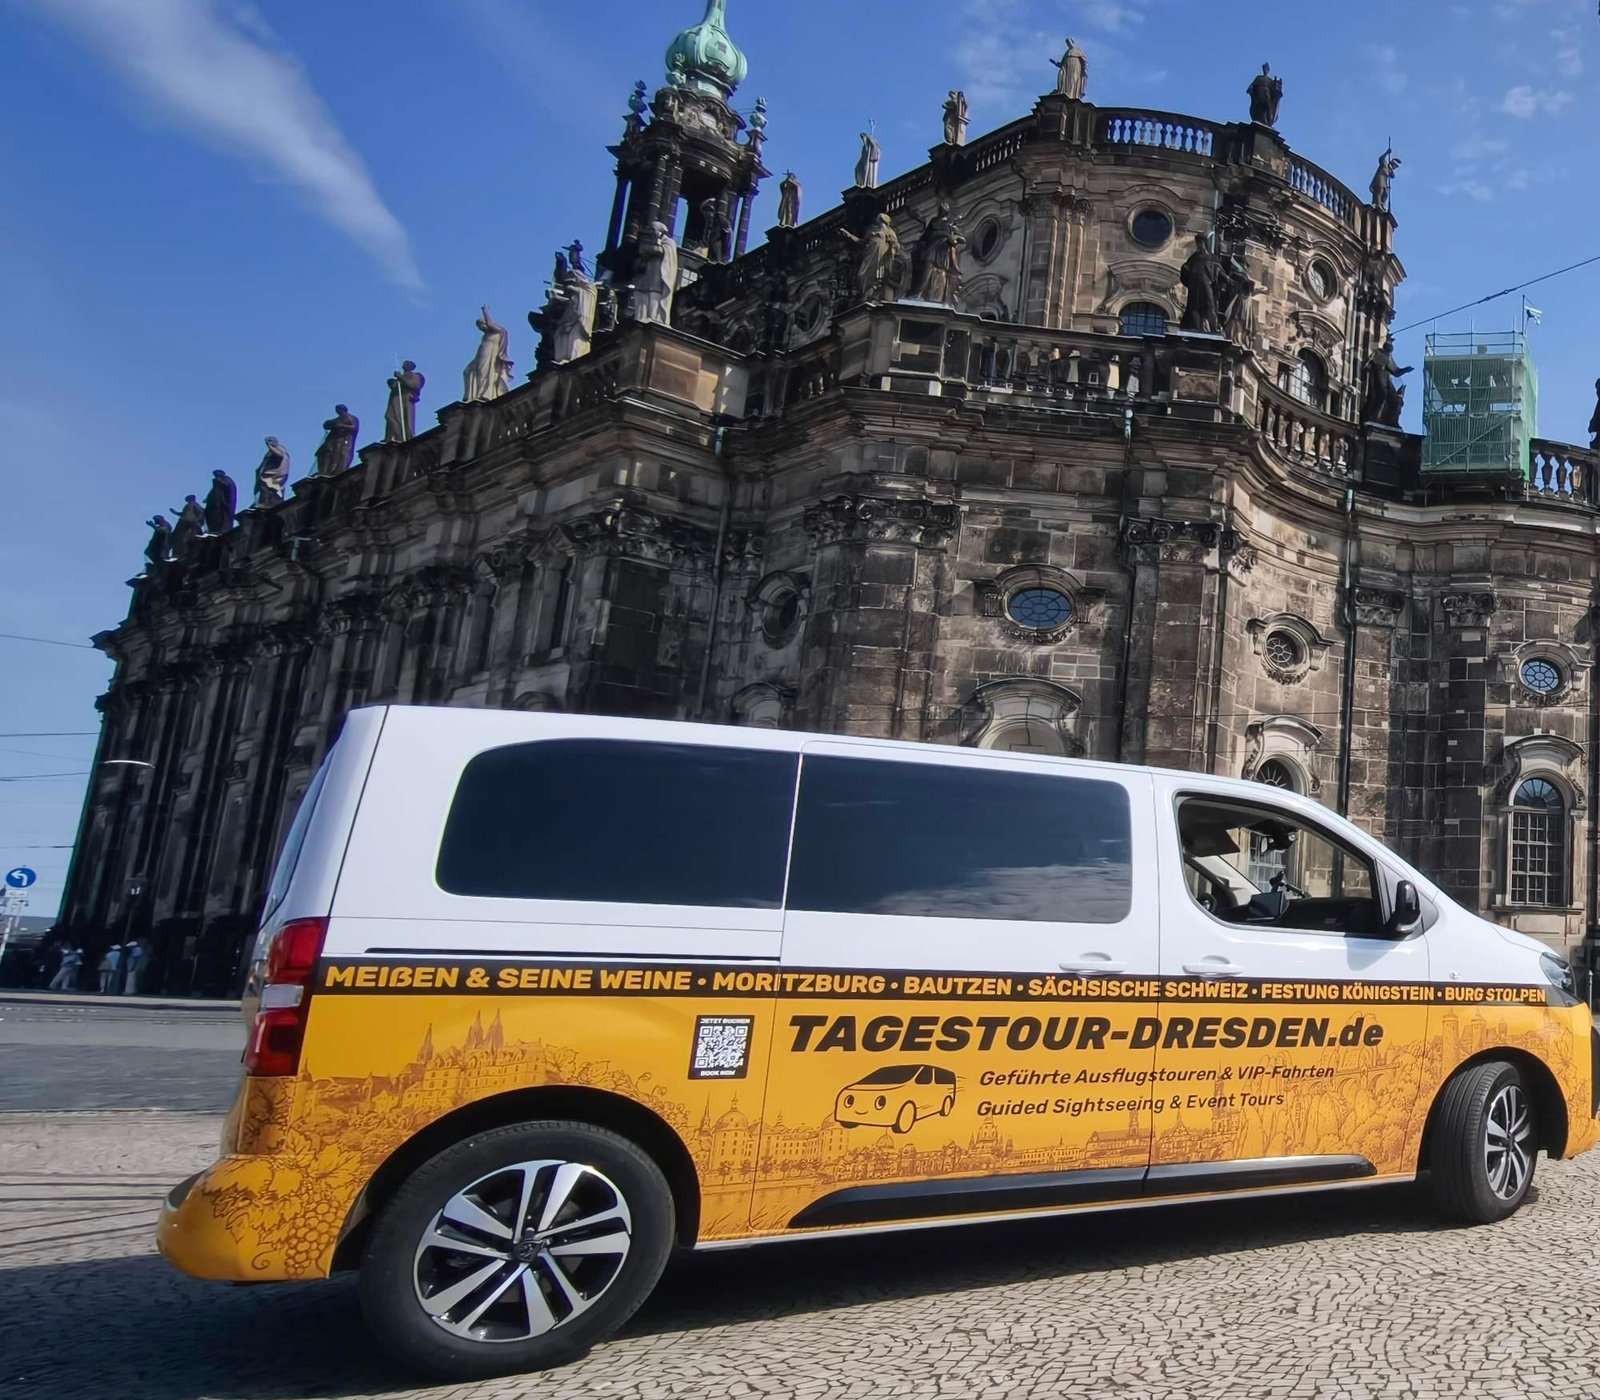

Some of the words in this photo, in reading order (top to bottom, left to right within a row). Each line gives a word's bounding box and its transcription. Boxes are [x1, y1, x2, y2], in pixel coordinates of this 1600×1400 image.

[465, 967, 490, 988] &
[497, 968, 593, 989] SEINE
[600, 969, 692, 990] WEINE
[712, 971, 887, 993] MORITZBURG
[903, 976, 1012, 995] BAUTZEN
[1028, 976, 1162, 997] SÄCHSISCHE
[1165, 982, 1249, 998] SCHWEIZ
[1261, 983, 1339, 1000] FESTUNG
[1343, 982, 1435, 1001] KÖNIGSTEIN
[1445, 986, 1484, 1002] BURG
[1485, 987, 1546, 1003] STOLPEN
[788, 1015, 1384, 1051] TAGESTOUR-DRESDEN.de
[979, 1068, 1071, 1087] Geführte
[1074, 1067, 1217, 1086] Ausflugstouren
[1221, 1066, 1233, 1081] &
[1237, 1065, 1334, 1081] VIP-Fahrten
[976, 1099, 1048, 1117] Guided
[1052, 1096, 1165, 1117] Sightseeing
[1169, 1095, 1182, 1110] &
[1186, 1093, 1236, 1109] Event
[1239, 1091, 1284, 1107] Tours
